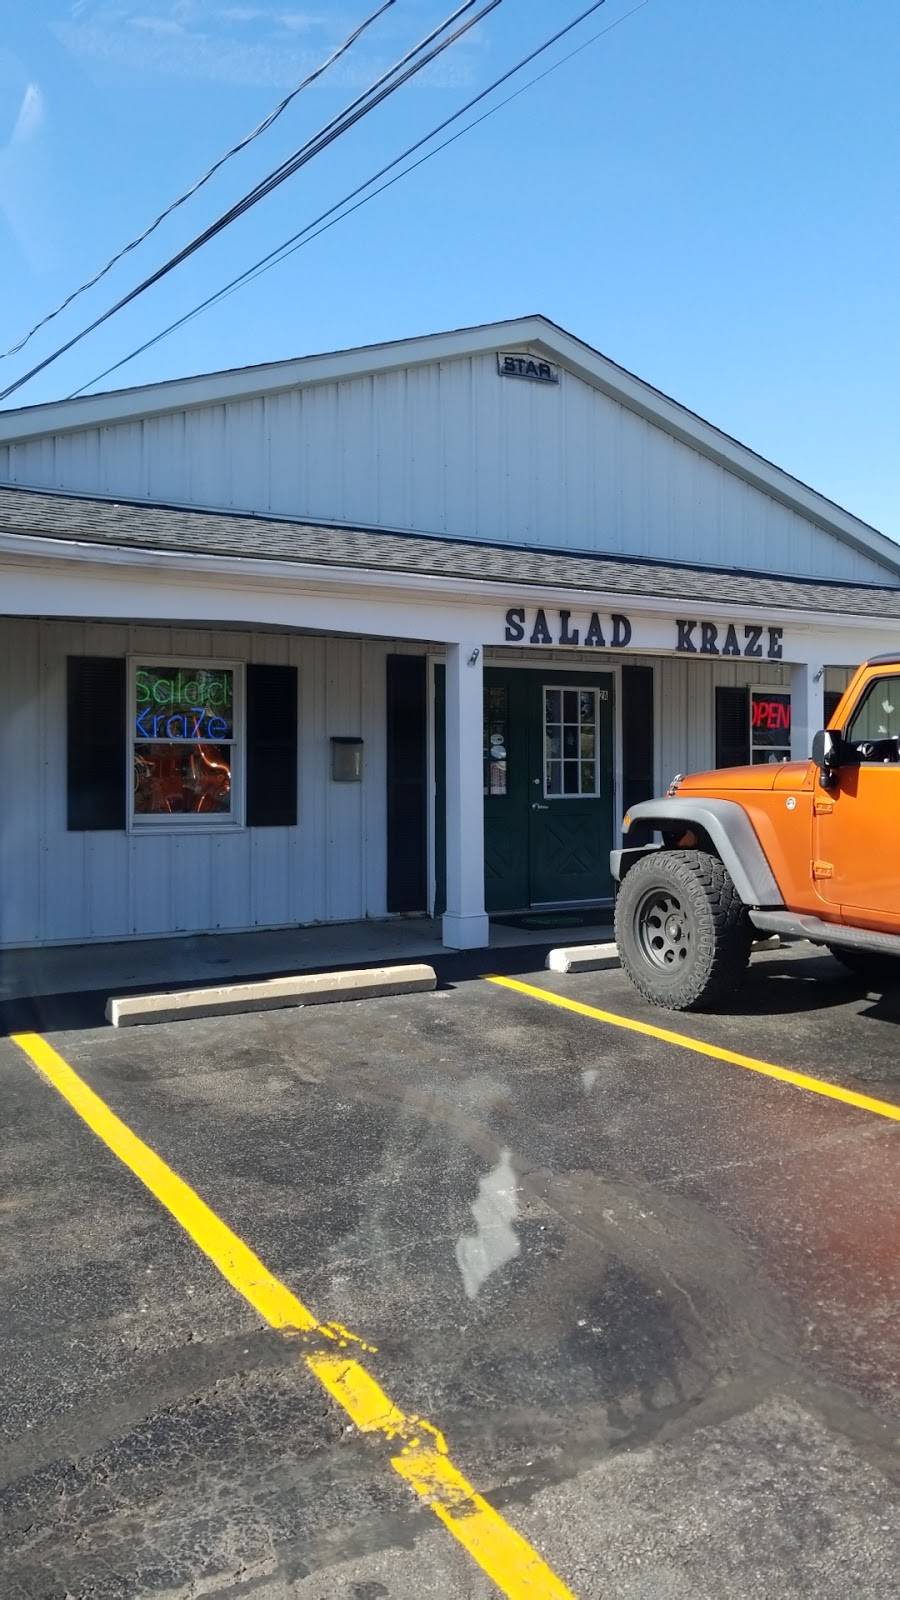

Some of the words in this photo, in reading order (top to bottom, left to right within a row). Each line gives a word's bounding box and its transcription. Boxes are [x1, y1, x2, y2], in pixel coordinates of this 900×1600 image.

[504, 356, 551, 378] STAR
[505, 608, 632, 648] SALAD
[675, 619, 784, 659] KRAZE
[136, 671, 228, 704] Salad
